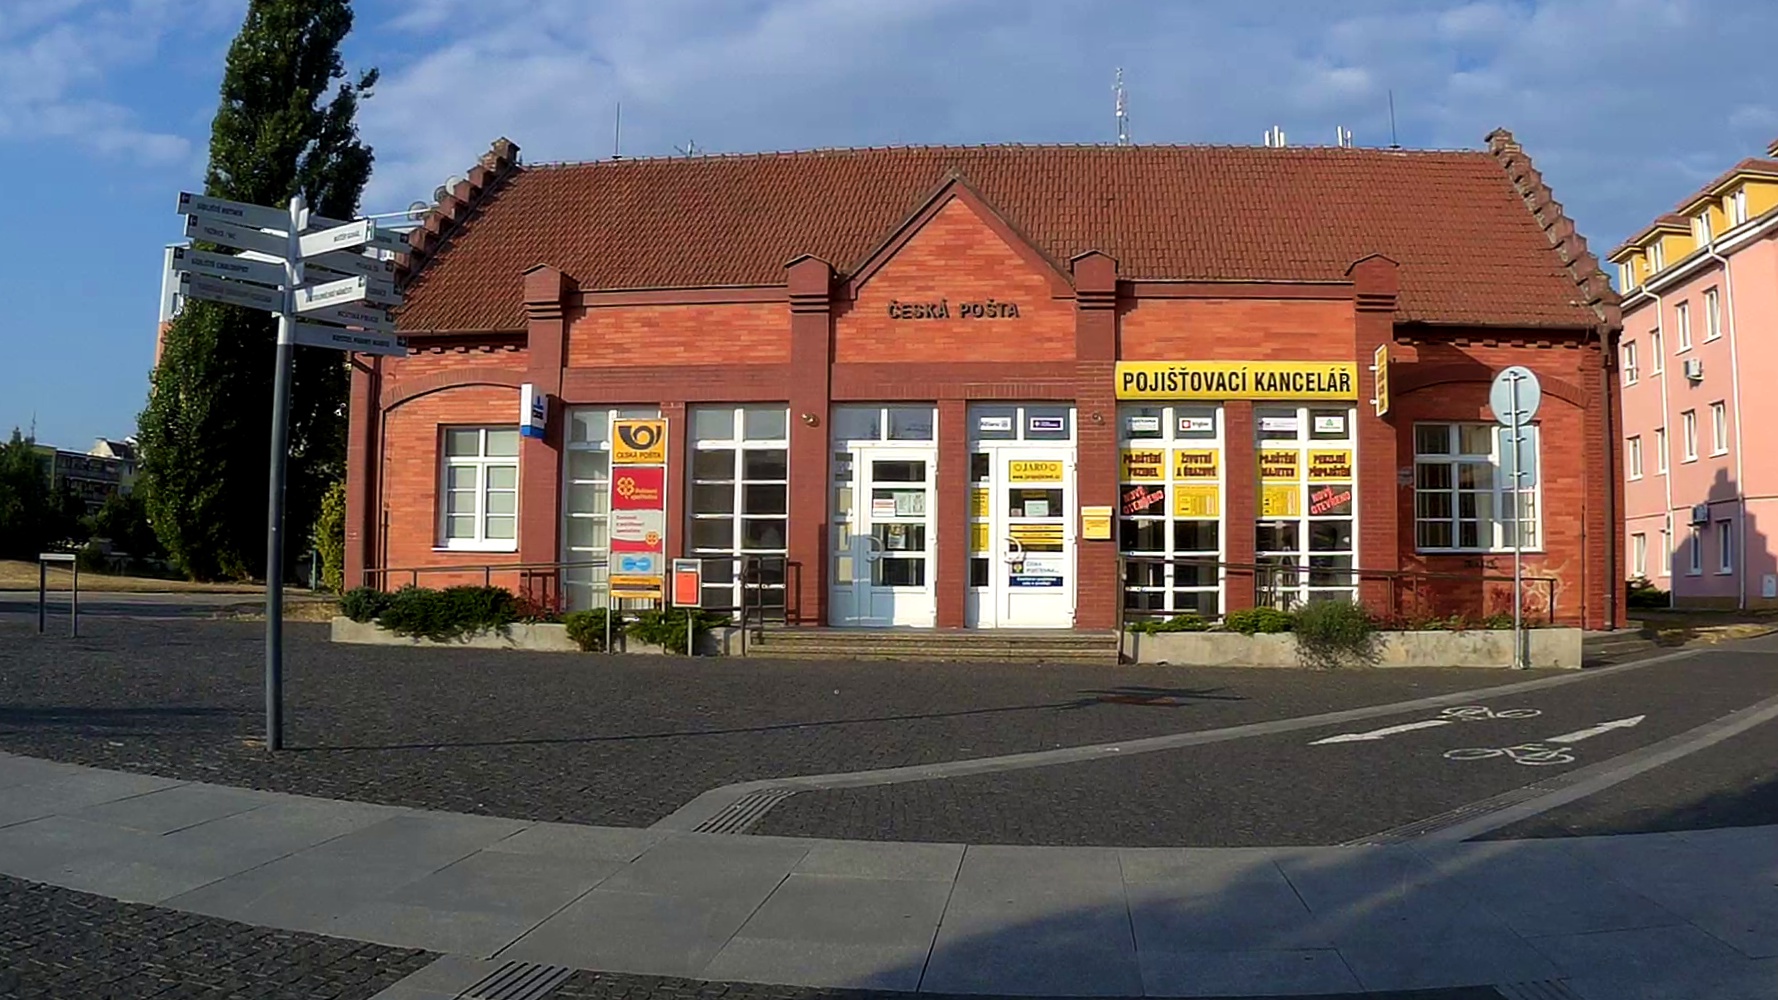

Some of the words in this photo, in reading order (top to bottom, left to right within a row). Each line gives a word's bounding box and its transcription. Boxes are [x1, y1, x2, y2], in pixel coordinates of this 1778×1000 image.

[889, 298, 950, 319] ČESKÁ
[960, 298, 1020, 319] POŠTA
[1123, 367, 1247, 392] POJIŠŤOVACÍ
[1254, 367, 1351, 392] KANCELÁŘ
[1023, 463, 1048, 472] JARO
